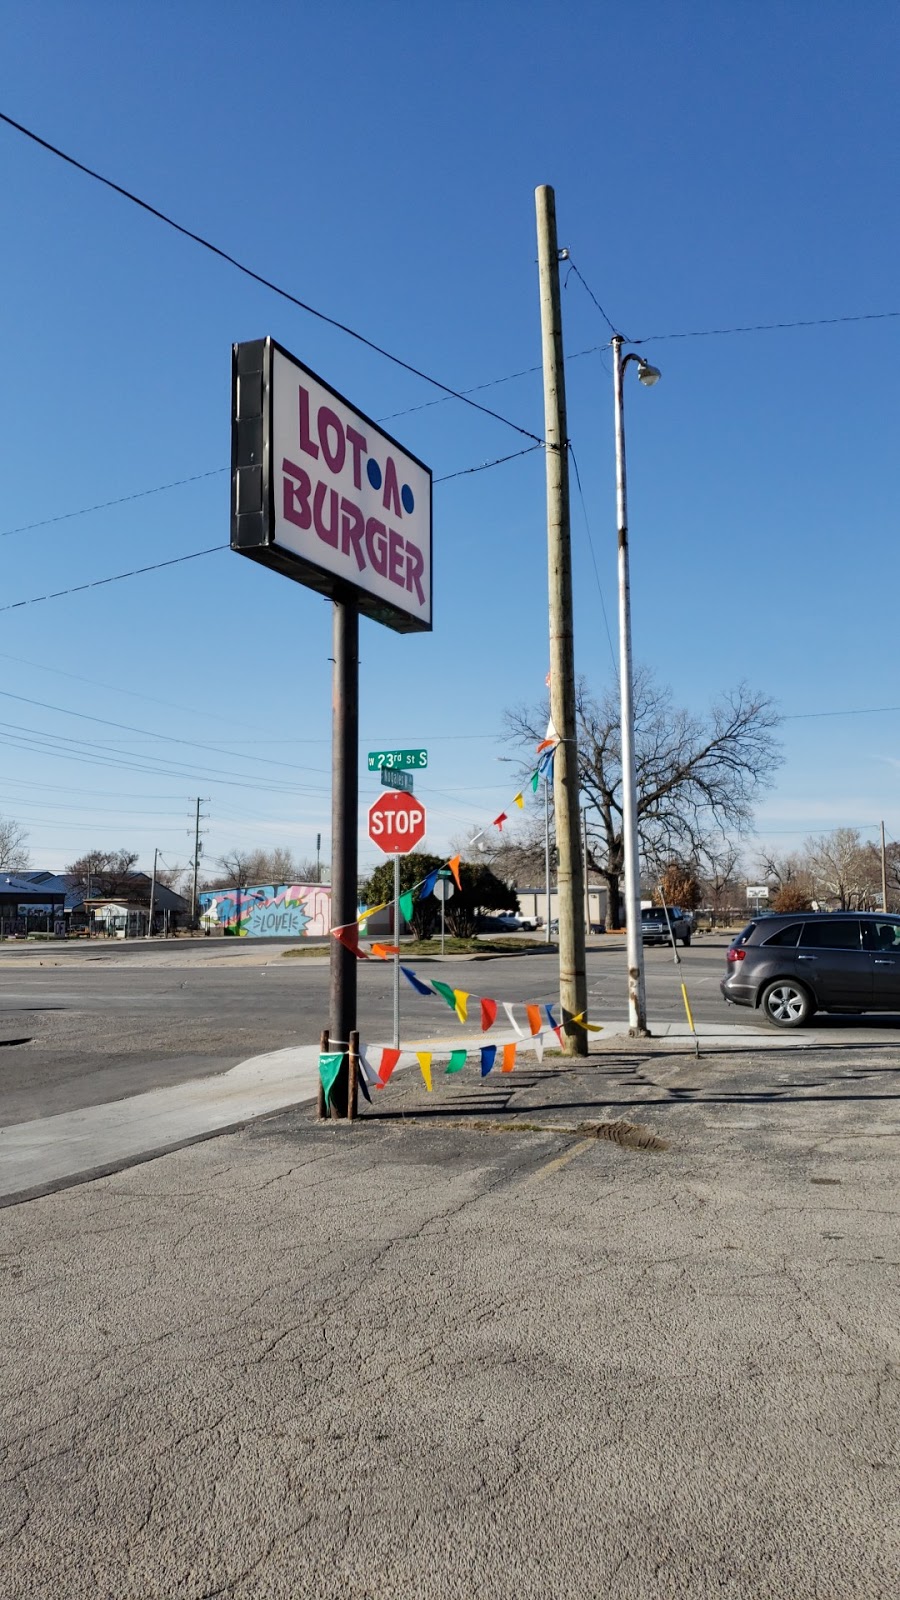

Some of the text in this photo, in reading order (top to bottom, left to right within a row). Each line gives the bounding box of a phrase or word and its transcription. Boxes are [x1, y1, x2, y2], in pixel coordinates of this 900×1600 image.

[282, 457, 426, 606] BURGER
[369, 758, 375, 766] W
[378, 753, 402, 769] 23rd
[419, 752, 427, 766] S
[371, 810, 423, 835] STOP
[260, 913, 293, 932] LOVE!
